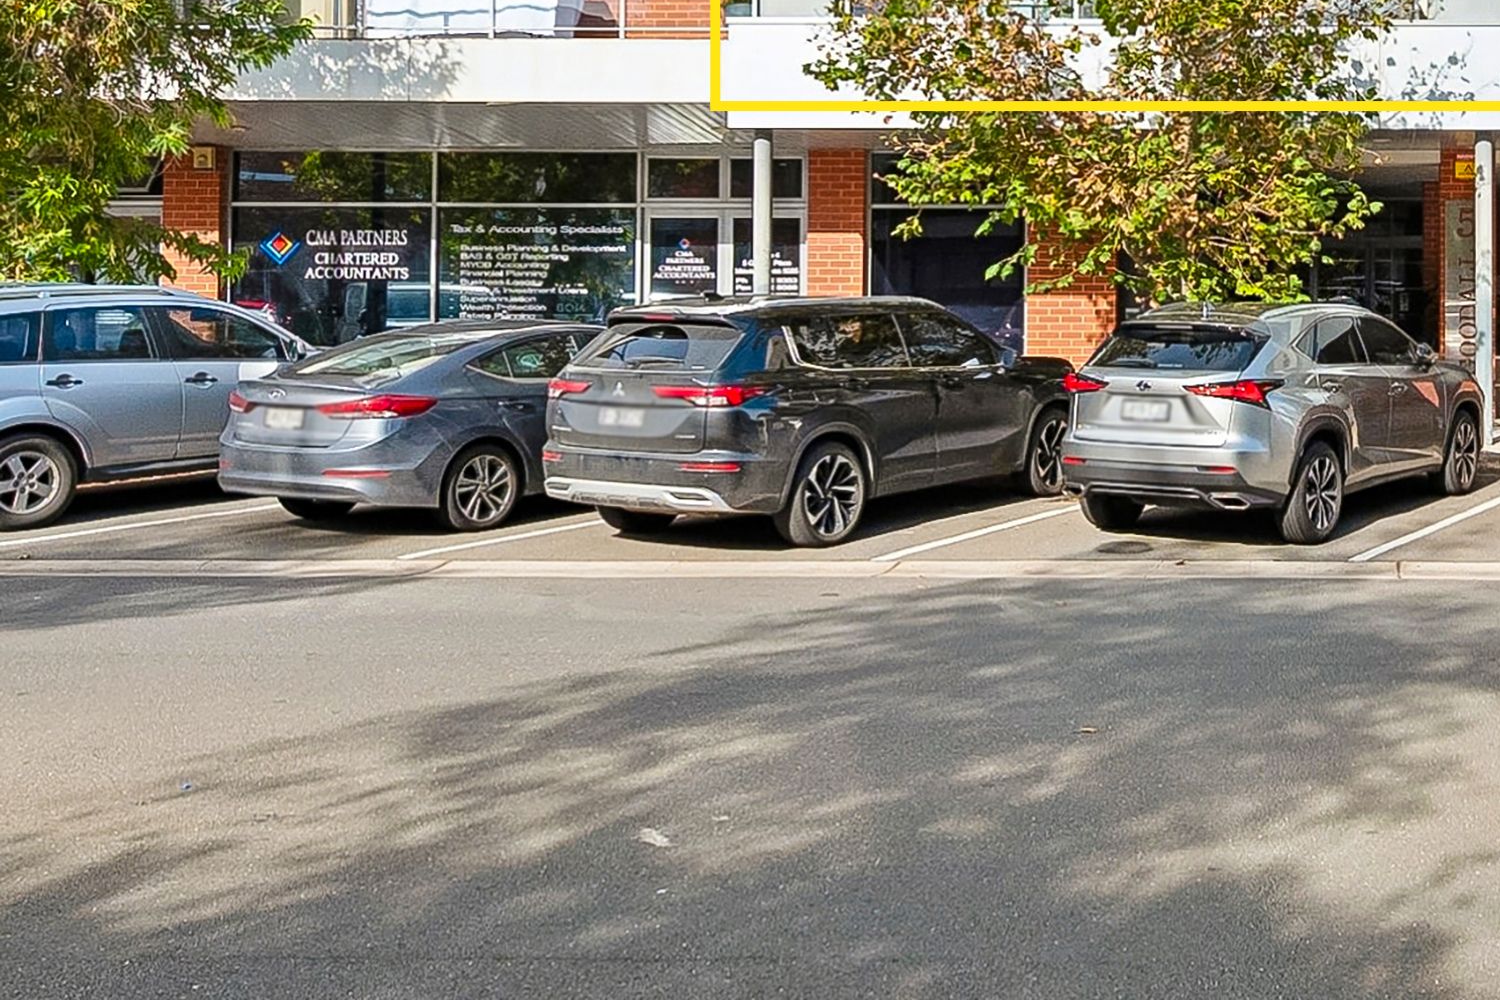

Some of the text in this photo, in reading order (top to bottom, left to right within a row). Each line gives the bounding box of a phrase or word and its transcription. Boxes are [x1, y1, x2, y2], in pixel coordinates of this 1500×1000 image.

[450, 224, 624, 236] Tax & Accounting Specialists
[306, 229, 408, 246] CMA PARTNERS
[507, 244, 549, 254] Planning
[562, 244, 627, 254] Development
[314, 252, 399, 265] CHARTERED
[521, 253, 570, 262] Reporting
[495, 261, 550, 270] Accounting
[304, 266, 410, 280] ACCOUNTANTS
